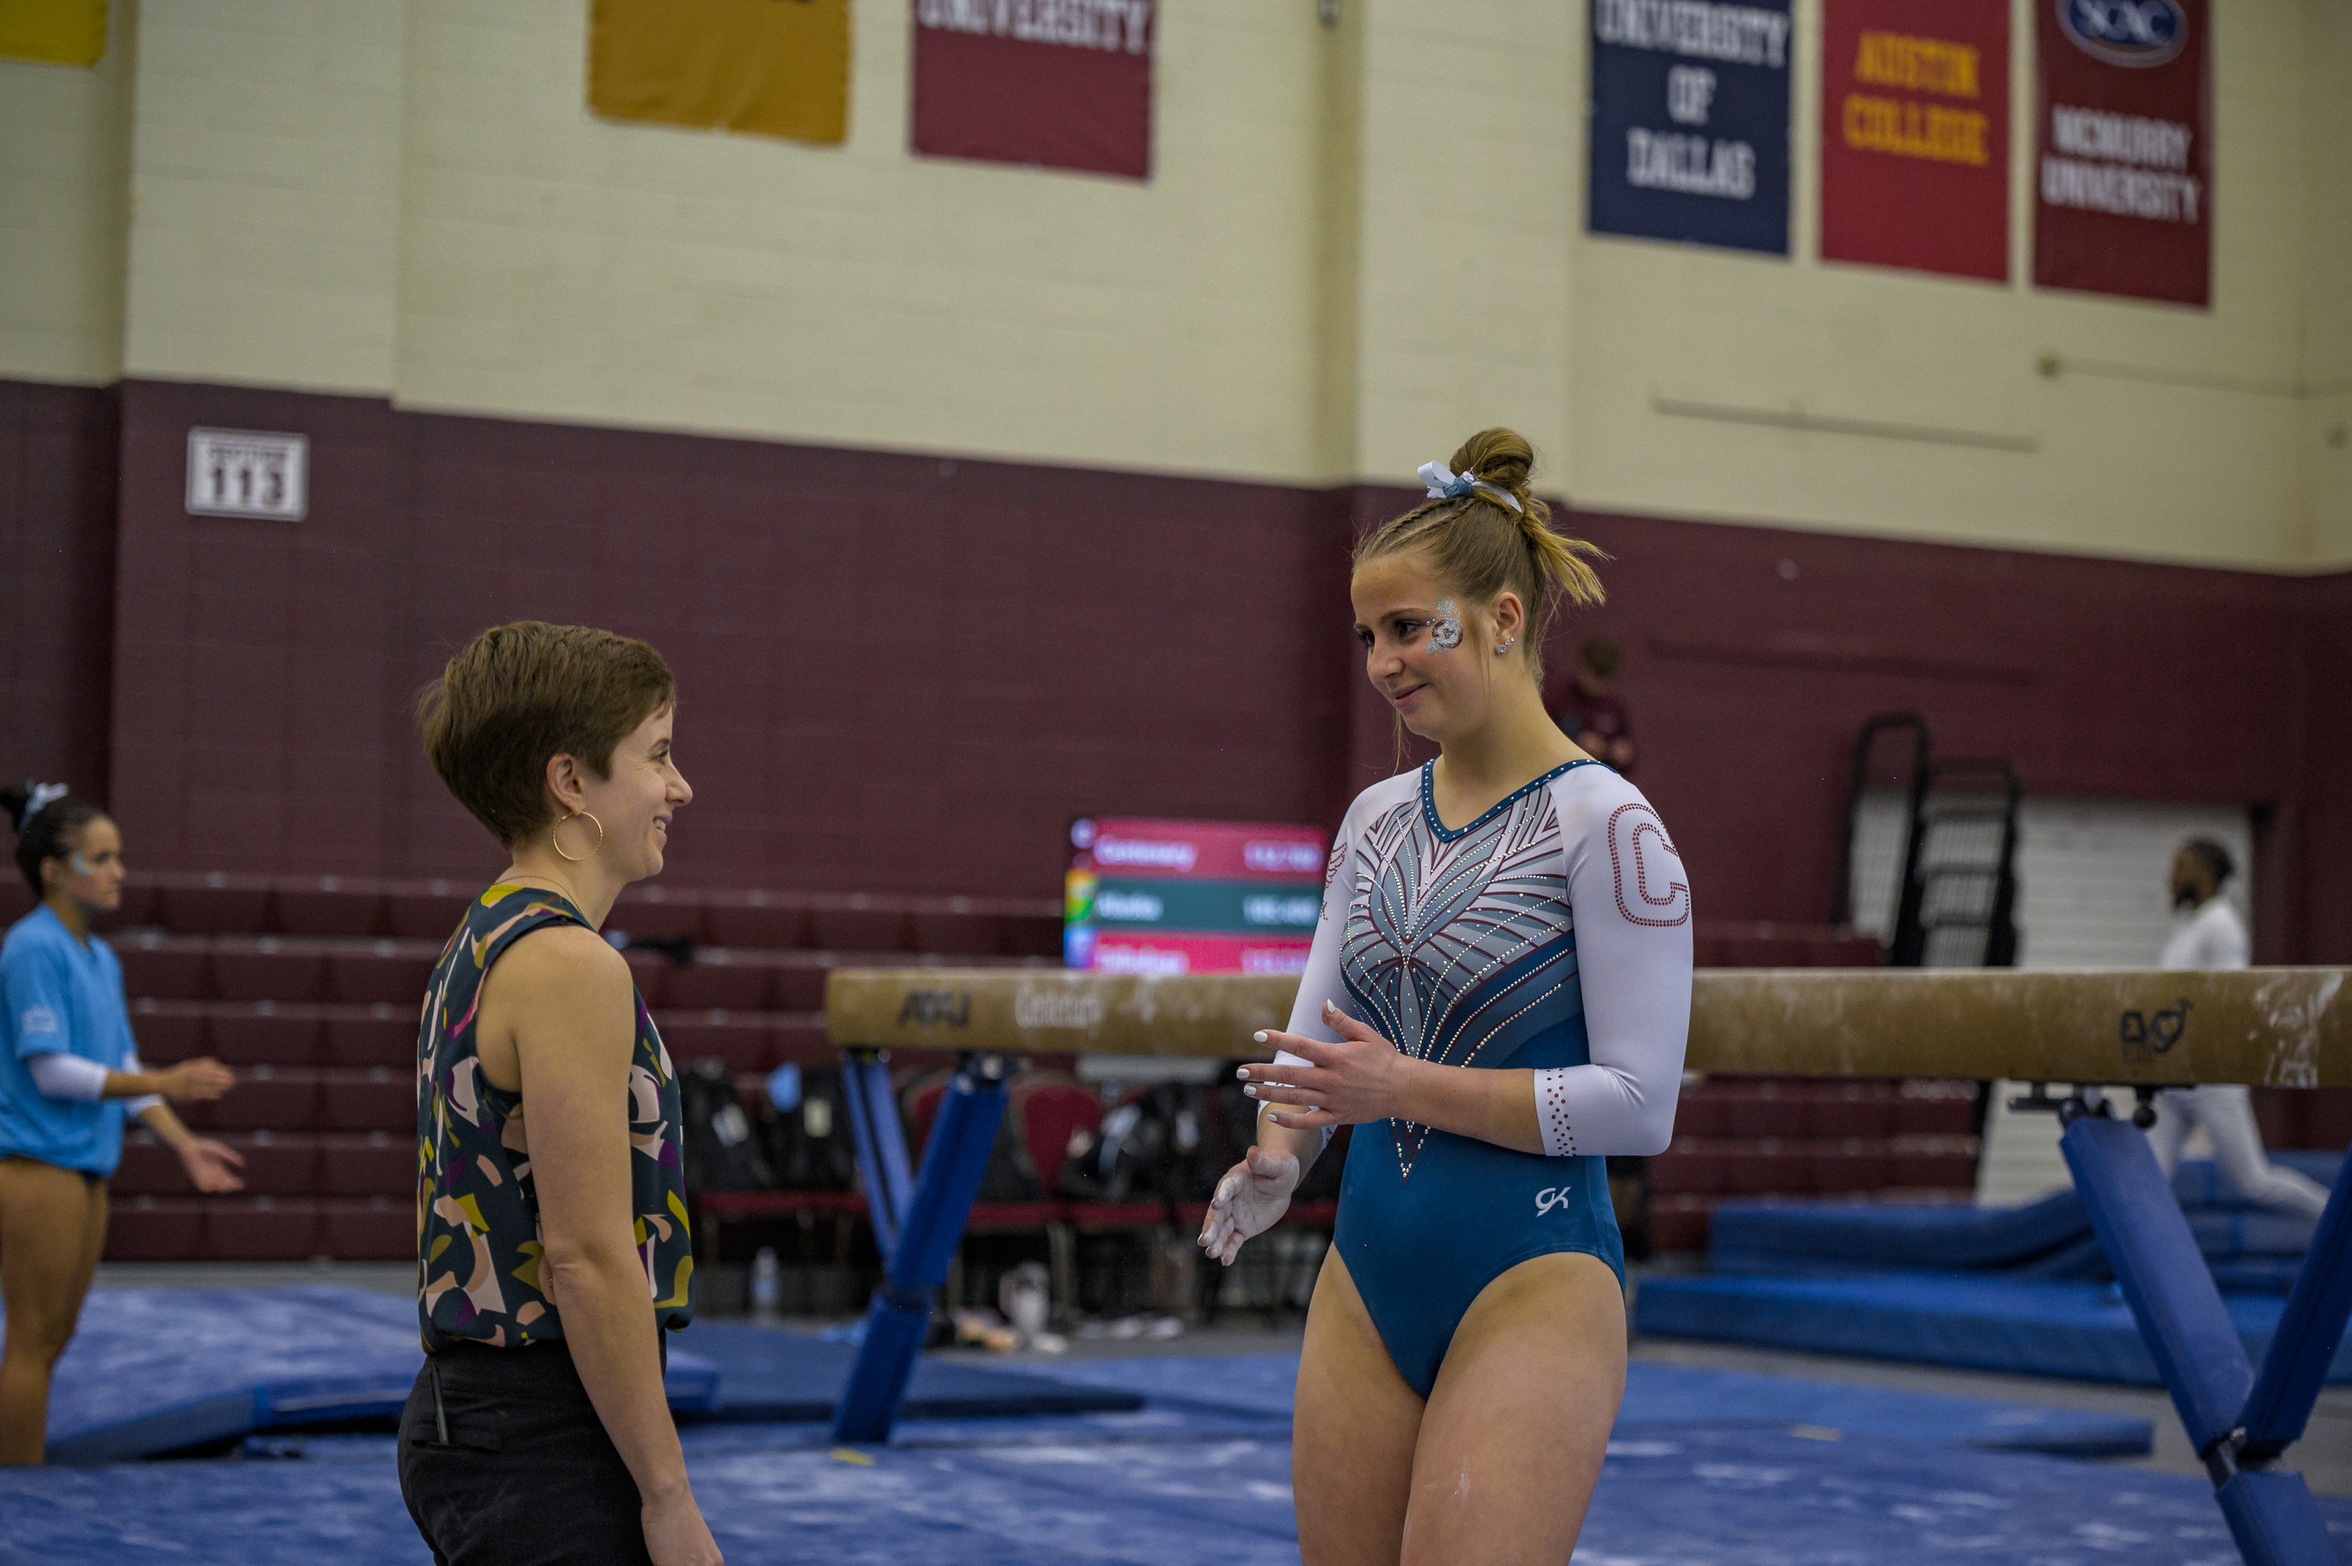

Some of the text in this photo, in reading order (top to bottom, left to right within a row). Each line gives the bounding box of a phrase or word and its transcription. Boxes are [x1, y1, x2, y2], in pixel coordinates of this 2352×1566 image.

[917, 0, 1149, 54] UNIVERSITY
[1596, 0, 1789, 69] UNIVERSITY
[1667, 64, 1717, 126] OF
[1855, 29, 1981, 98] AUSTIN
[1627, 127, 1757, 200] DALLAS
[1843, 93, 1989, 166] COLLEGE
[2053, 103, 2193, 172] MCMURRY
[2041, 154, 2200, 224] UNIVERSITY
[211, 463, 285, 505] 113
[1608, 803, 1690, 927] C
